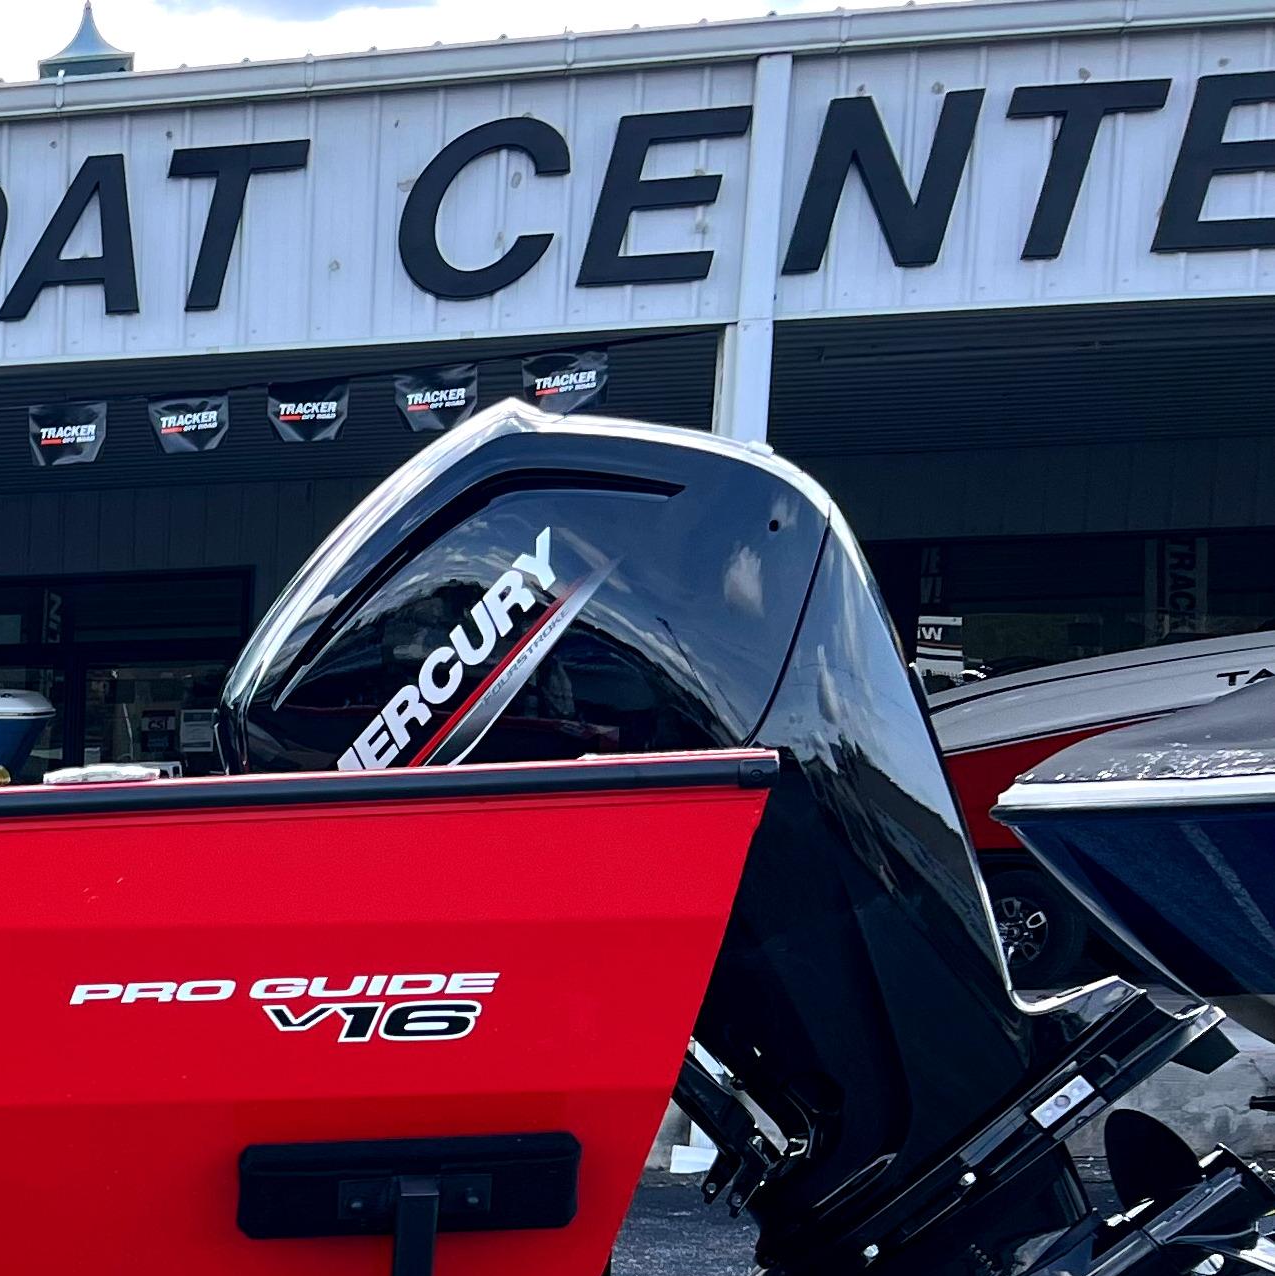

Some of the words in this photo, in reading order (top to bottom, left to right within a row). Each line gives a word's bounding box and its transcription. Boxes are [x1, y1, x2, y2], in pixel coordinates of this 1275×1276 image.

[398, 70, 1275, 300] CENTE
[535, 371, 596, 388] TRACKER
[407, 388, 466, 405] TRACKER
[279, 402, 337, 414] TRACKER
[161, 411, 217, 426] TRACKER
[40, 425, 96, 438] TRACKER
[482, 608, 570, 705] FOURSTROKE
[69, 980, 235, 1005] PRO
[249, 972, 500, 999] GUIDE
[262, 999, 482, 1043] V16
